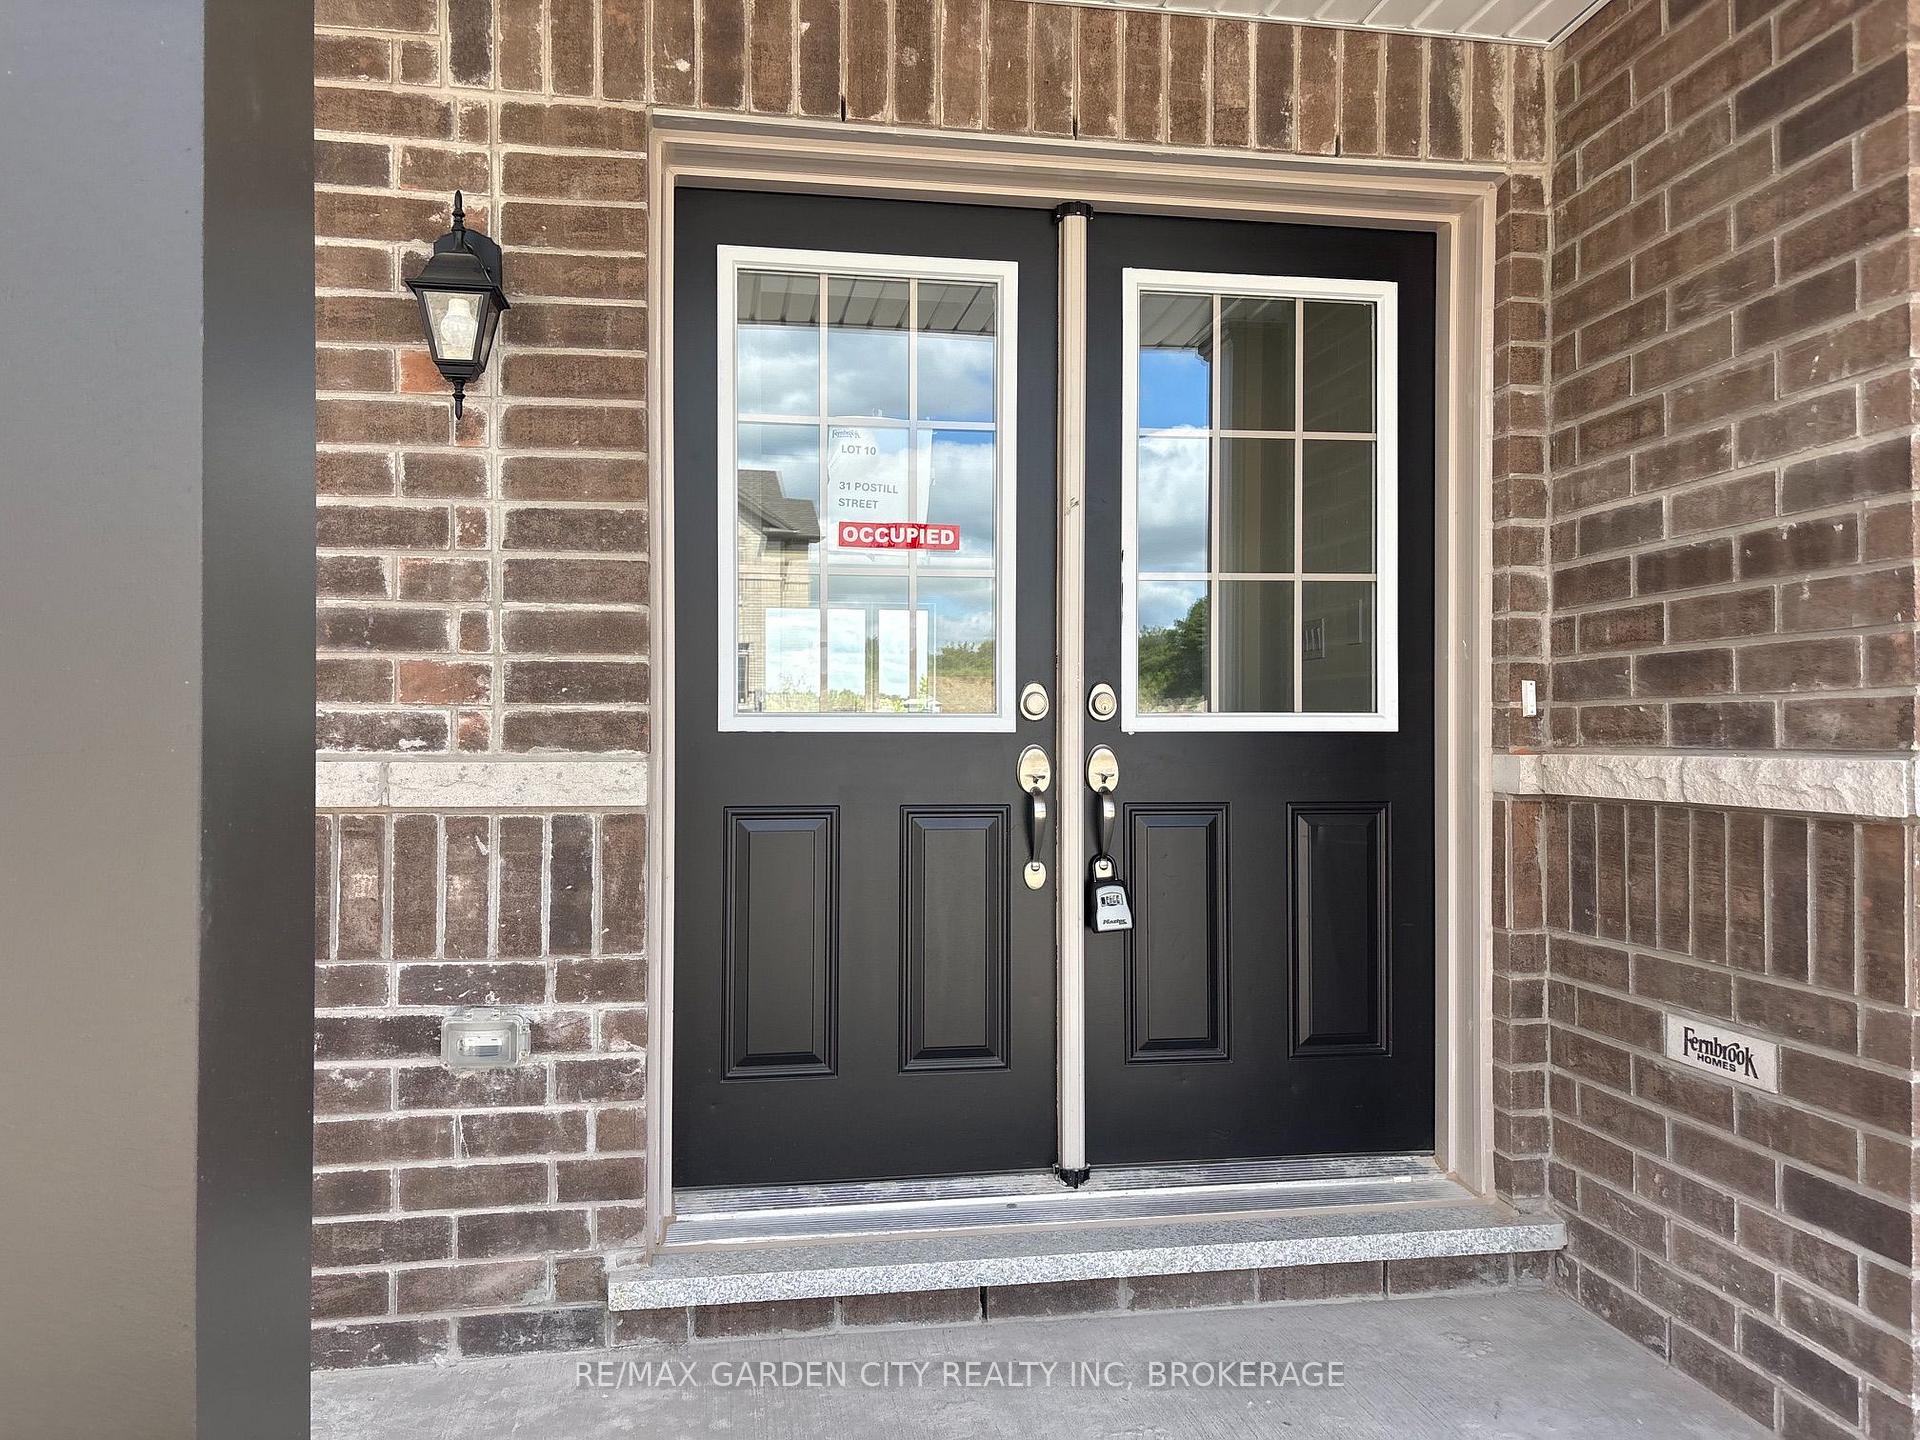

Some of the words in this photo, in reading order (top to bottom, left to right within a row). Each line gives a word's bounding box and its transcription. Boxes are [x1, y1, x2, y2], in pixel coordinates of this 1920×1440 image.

[841, 444, 861, 455] LOT
[864, 446, 877, 456] 10
[839, 481, 851, 491] 31
[855, 482, 898, 494] POSTILL
[838, 498, 878, 509] STREET
[842, 526, 954, 545] OCCUPIED
[1683, 1026, 1759, 1079] Fernbrook
[1697, 1053, 1736, 1072] HOMES
